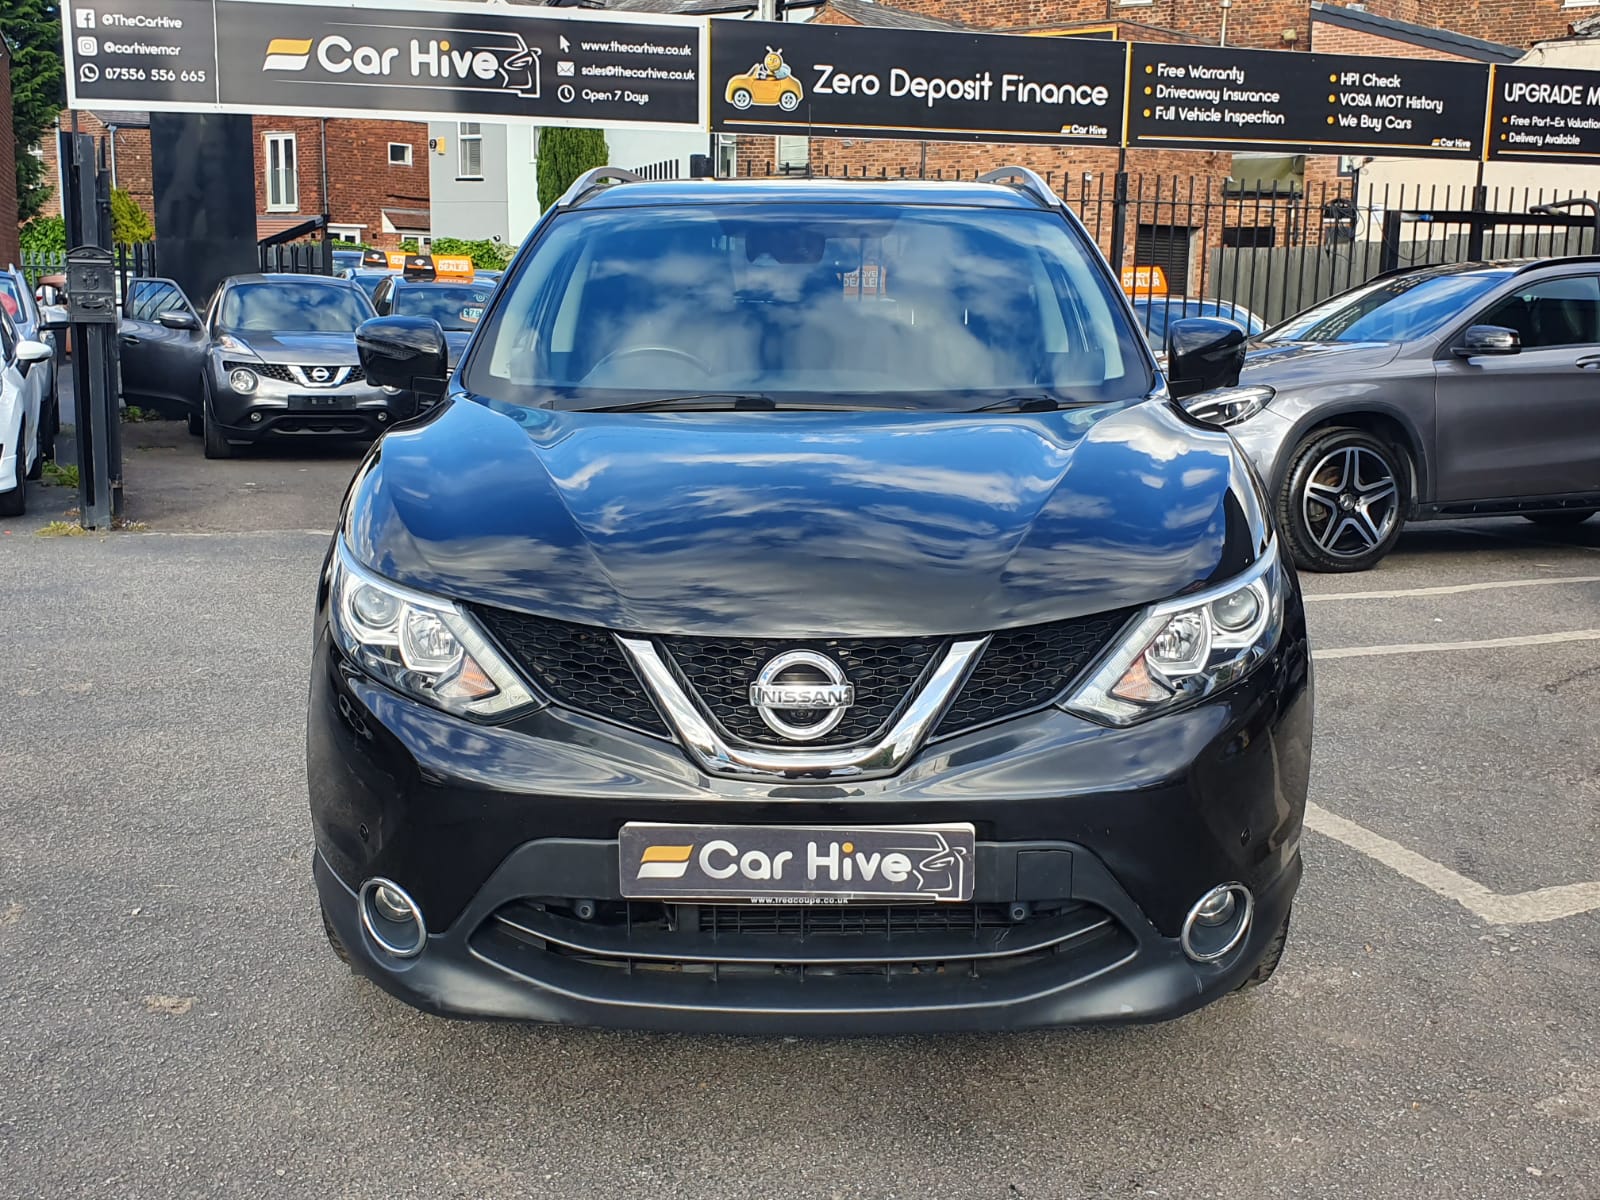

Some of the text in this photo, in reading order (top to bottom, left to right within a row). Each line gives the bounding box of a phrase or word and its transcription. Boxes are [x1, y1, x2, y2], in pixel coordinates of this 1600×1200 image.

[102, 14, 182, 29] @TheCarHive
[104, 41, 181, 56] @carhivemcr
[581, 41, 692, 56] www.thecarhive.co.uk
[317, 35, 499, 80] Car Hive
[105, 68, 206, 82] 07556 556 665
[581, 65, 695, 81] sales@thecarhive.co.uk
[1157, 63, 1245, 84] Free Warranty
[1340, 72, 1401, 88] HPI Check
[812, 65, 1109, 108] Zero Deposit Finance
[1156, 84, 1280, 104] Driveaway Insurance
[1504, 82, 1583, 105] UPGRADE
[582, 89, 649, 105] Open 7 Days
[1340, 93, 1444, 114] VOSA MOT History
[1155, 106, 1285, 127] Full Vehicle Inspection
[1338, 113, 1412, 132] We Buy Cars
[1510, 115, 1531, 126] Free
[1532, 116, 1565, 128] Part-Ex
[1071, 124, 1108, 135] Car Hive
[1508, 132, 1581, 147] Delivery Available
[761, 690, 843, 703] NISSAN
[699, 840, 912, 882] Car Hive
